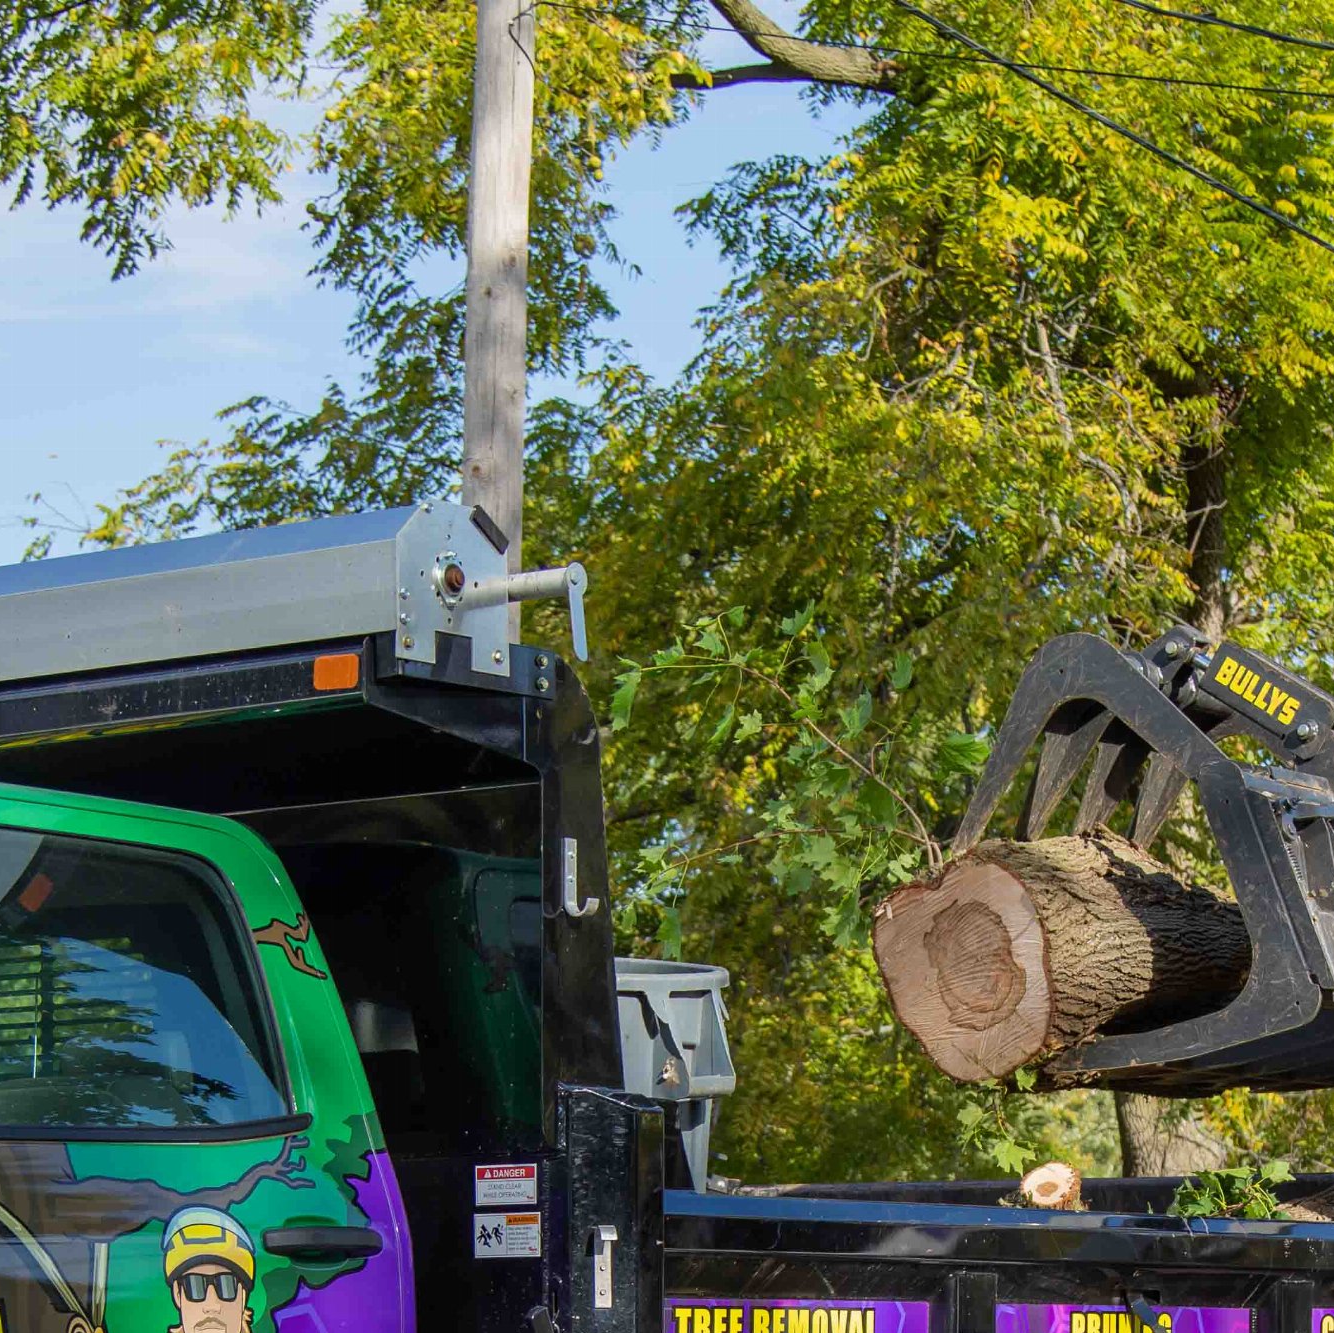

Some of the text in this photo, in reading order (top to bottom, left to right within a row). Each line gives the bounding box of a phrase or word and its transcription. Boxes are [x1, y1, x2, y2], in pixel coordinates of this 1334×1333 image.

[1214, 656, 1301, 726] BULLYS
[493, 1168, 526, 1178] DANGER
[505, 1182, 522, 1190] CLEAR
